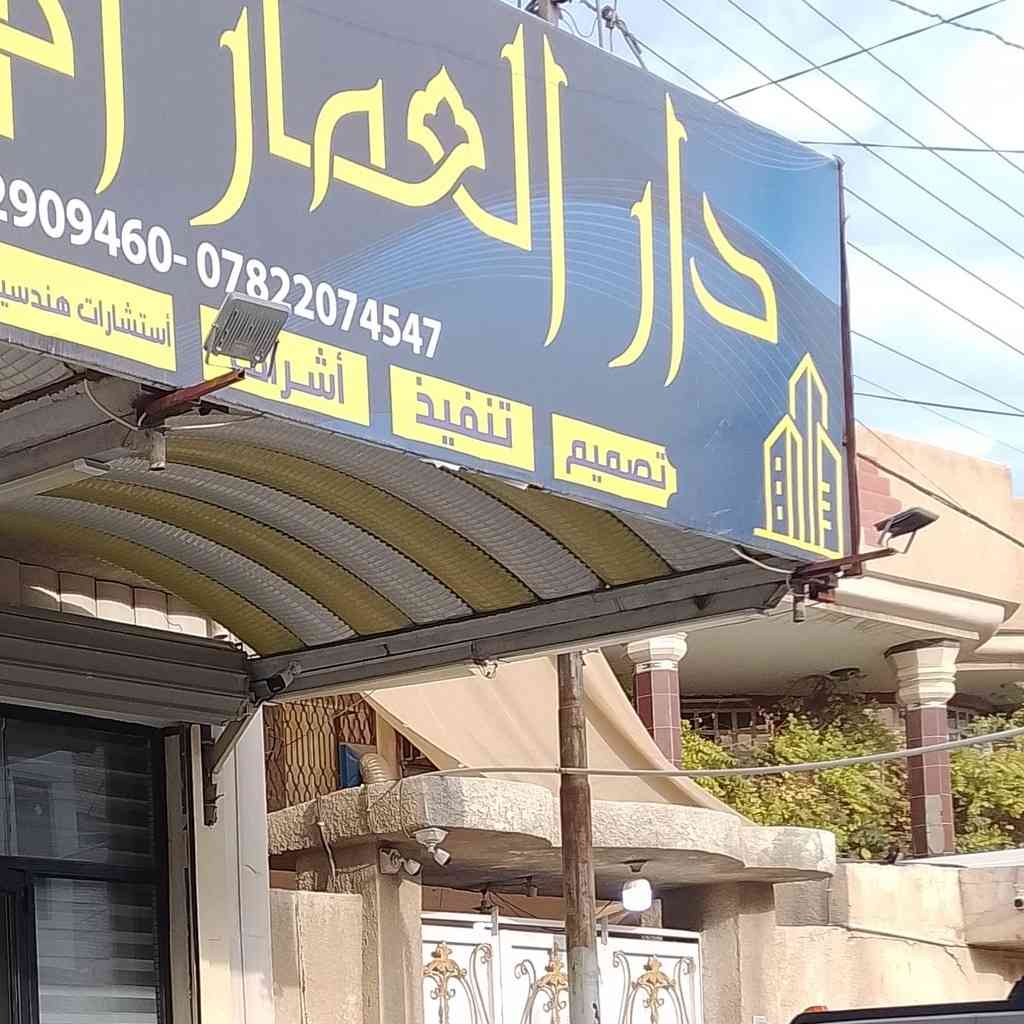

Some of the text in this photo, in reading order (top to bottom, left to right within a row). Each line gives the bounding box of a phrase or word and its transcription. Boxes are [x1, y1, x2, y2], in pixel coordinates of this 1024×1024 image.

[608, 93, 779, 388] دار
[416, 376, 513, 448] تنفيذ
[566, 439, 667, 490] تصميم
